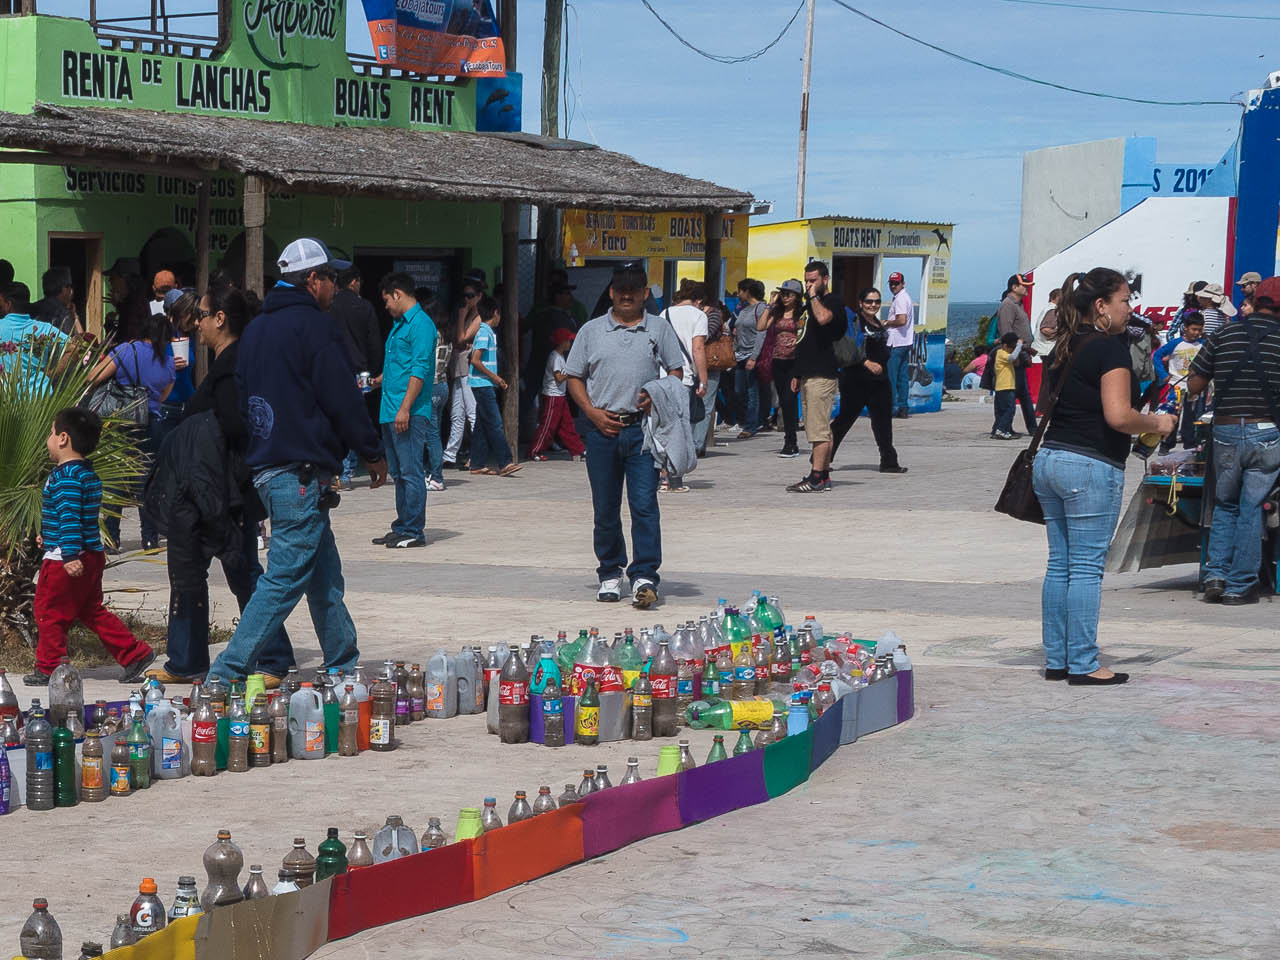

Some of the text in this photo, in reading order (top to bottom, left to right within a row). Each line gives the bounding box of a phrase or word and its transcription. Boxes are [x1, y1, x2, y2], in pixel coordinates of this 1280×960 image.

[62, 49, 271, 114] RENTA DE LANCHAS
[334, 77, 455, 126] BOATS RENT
[157, 175, 235, 198] Turiscos
[1172, 168, 1214, 193] 201
[670, 217, 702, 239] BOATS
[833, 226, 860, 248] BOATS
[860, 227, 882, 248] RENT
[601, 231, 627, 253] Faro
